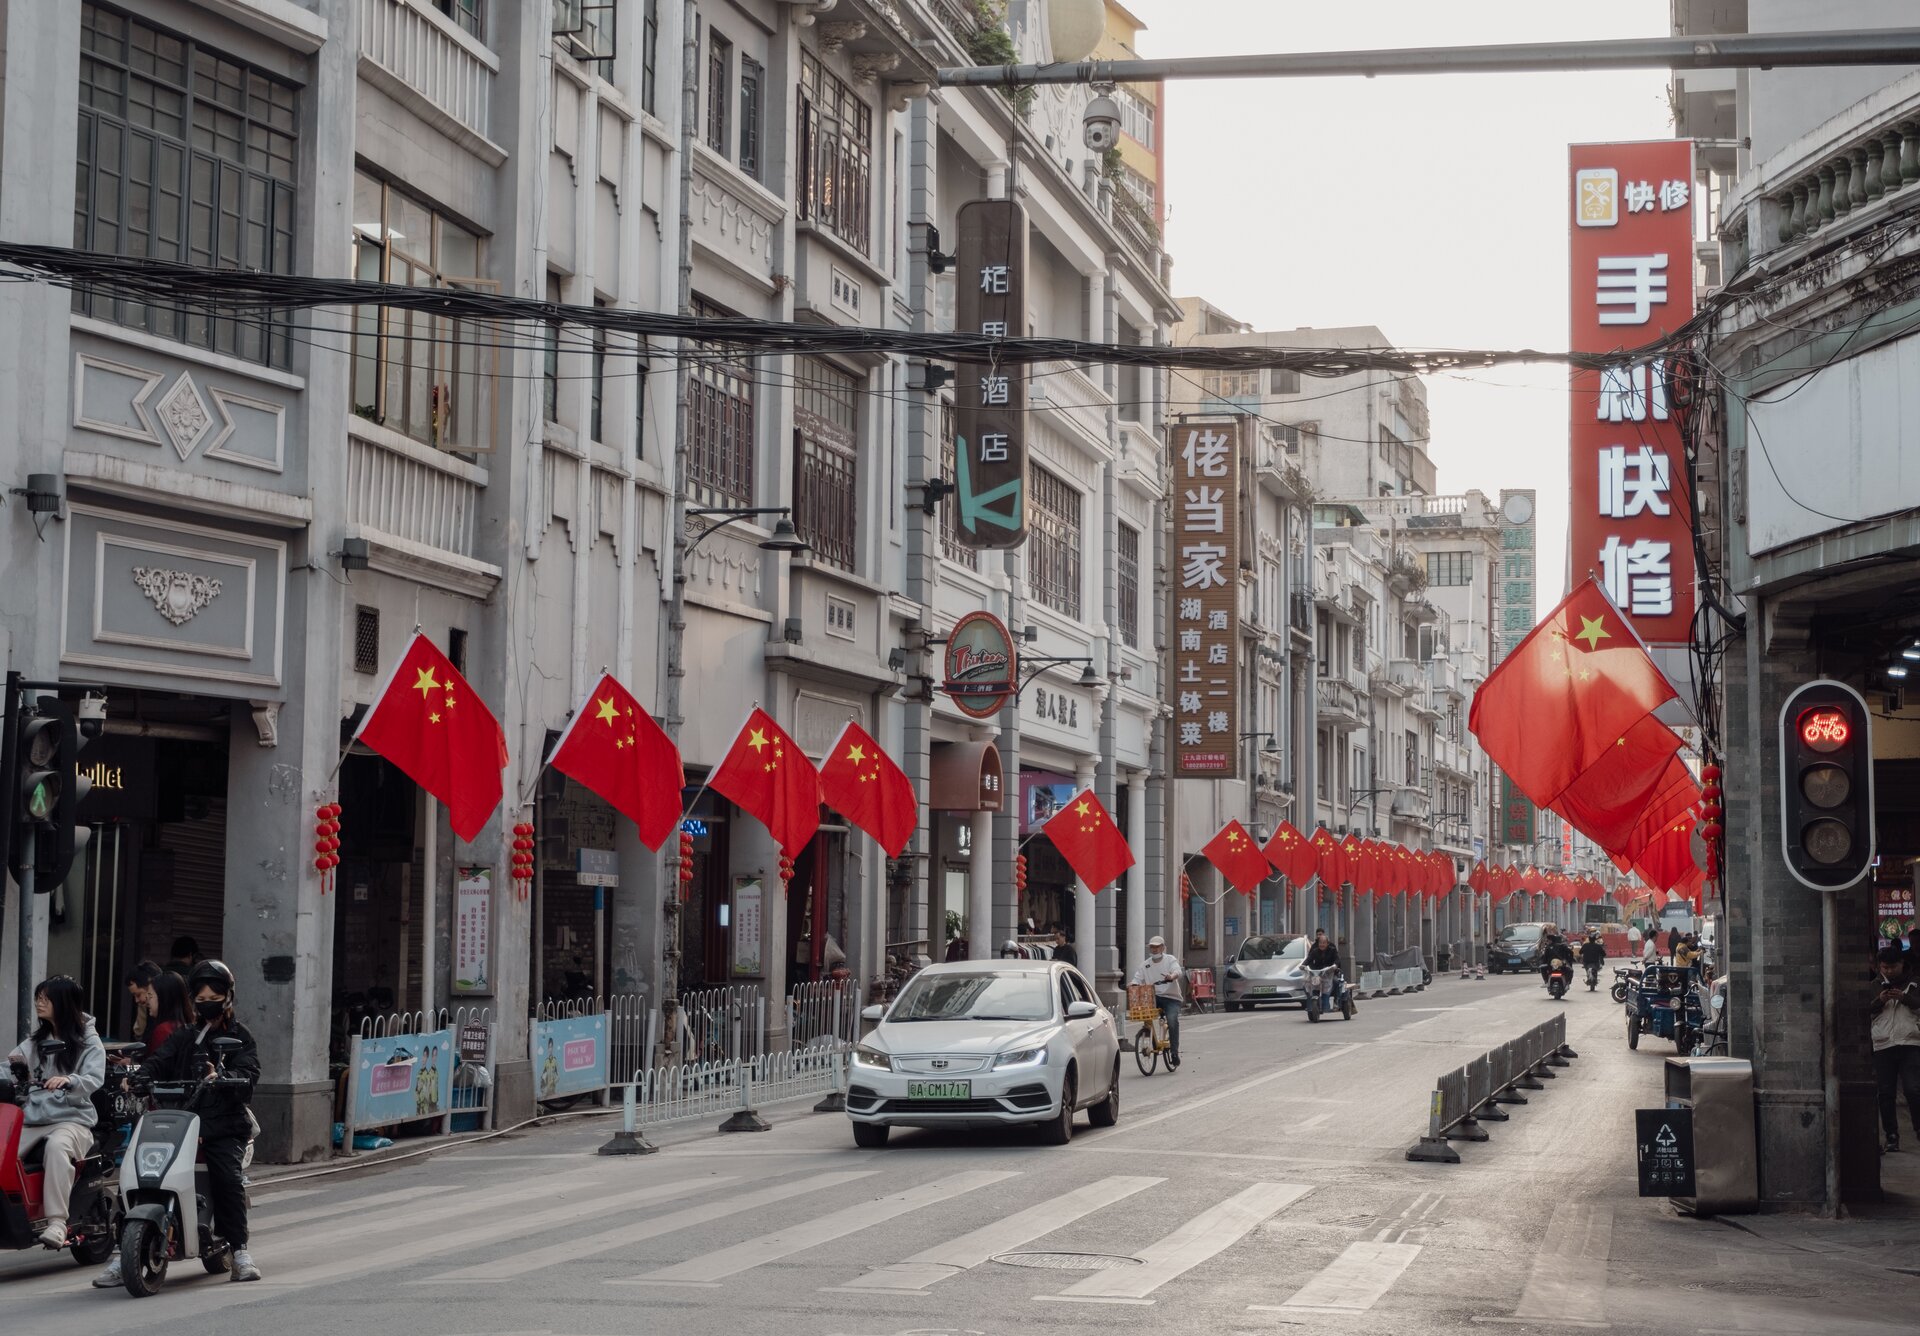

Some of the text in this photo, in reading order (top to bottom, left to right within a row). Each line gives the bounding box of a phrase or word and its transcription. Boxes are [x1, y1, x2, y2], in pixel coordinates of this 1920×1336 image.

[1624, 180, 1690, 212] 快修
[1182, 429, 1229, 590] 佬当家
[952, 645, 1008, 680] Thirteen
[1180, 598, 1202, 746] 湖南土钵菜
[1208, 609, 1228, 734] 酒店二楼
